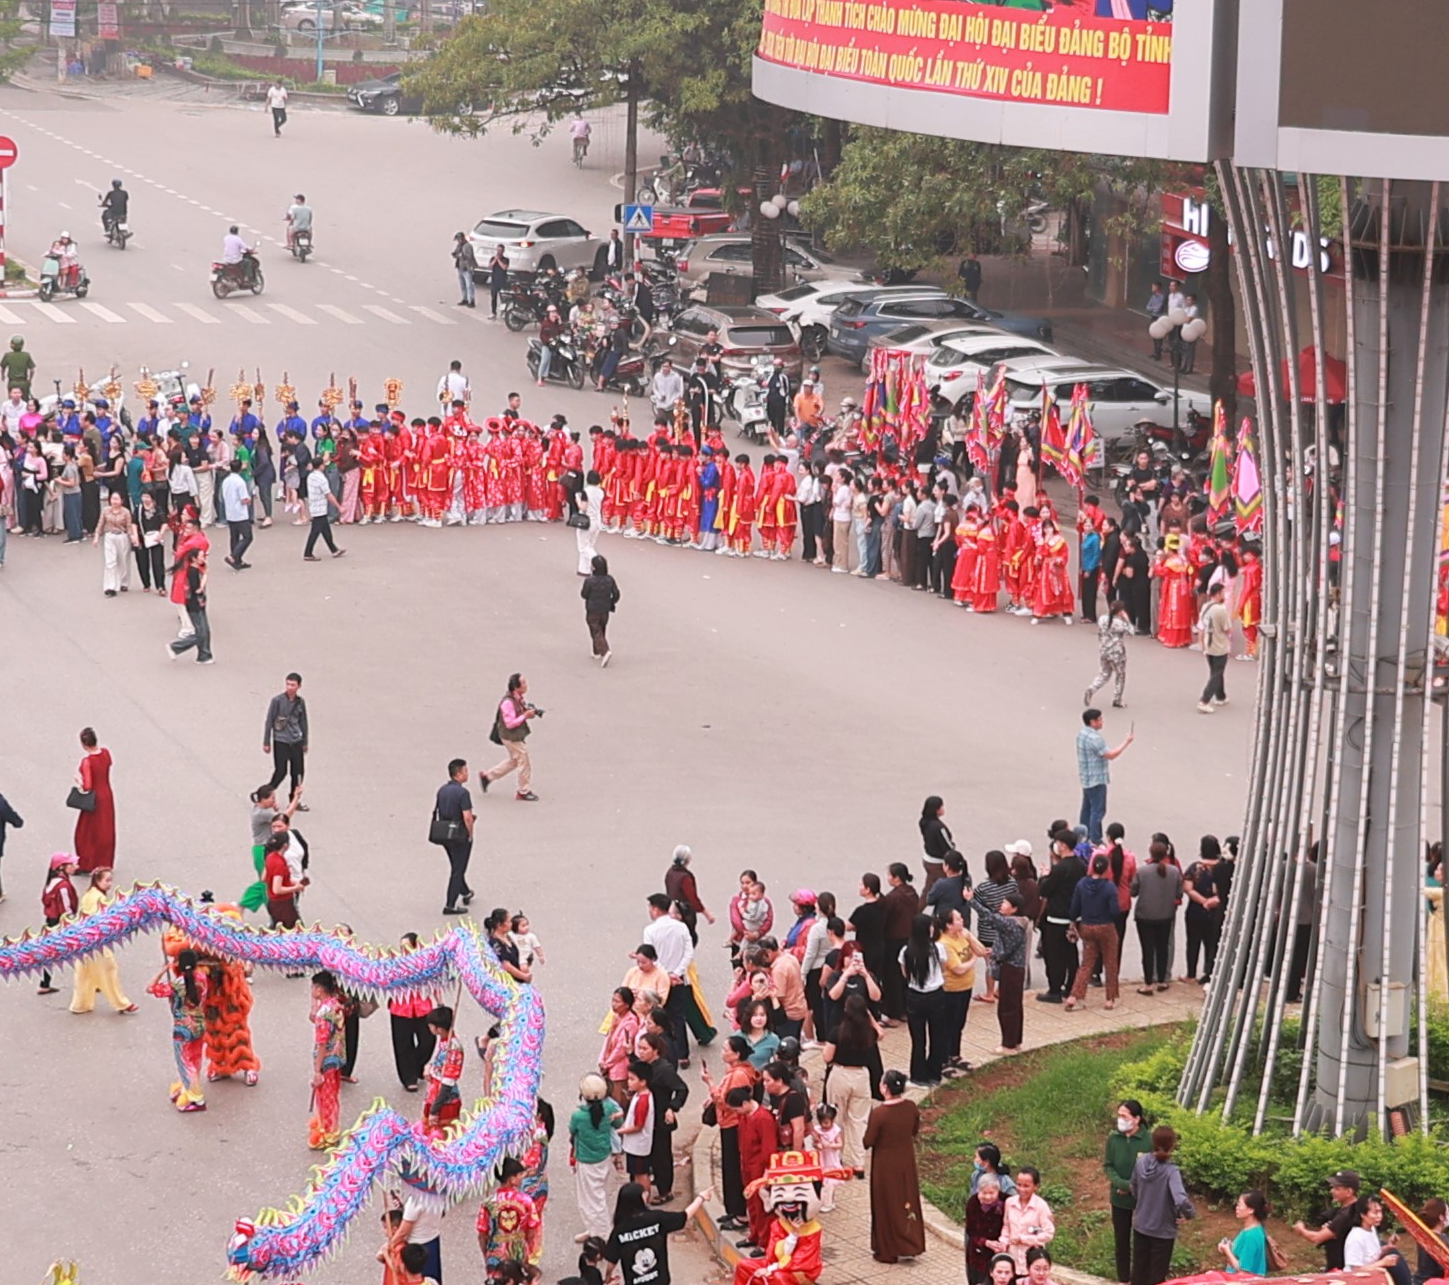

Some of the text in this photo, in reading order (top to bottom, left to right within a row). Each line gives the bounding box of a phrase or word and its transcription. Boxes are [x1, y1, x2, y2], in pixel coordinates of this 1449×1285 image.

[866, 0, 895, 35] CHÀO
[895, 4, 937, 39] MỪNG
[937, 13, 963, 47] ĐẠI
[964, 10, 990, 50] HỘI
[990, 18, 1017, 54] ĐẠI
[1017, 13, 1056, 54] BIỂU
[1058, 19, 1105, 59] ĐẢNG
[1107, 26, 1132, 66] BỘ
[1135, 25, 1172, 64] TỈNH
[835, 36, 860, 75] BIỂU
[858, 44, 889, 80] TOÀN
[887, 46, 924, 84] QUỐC
[923, 49, 958, 89] LẦN
[954, 58, 984, 91] THỨ
[982, 64, 1010, 95] XIV
[1010, 61, 1043, 100] CỦA
[1045, 65, 1092, 105] ĐẢNG
